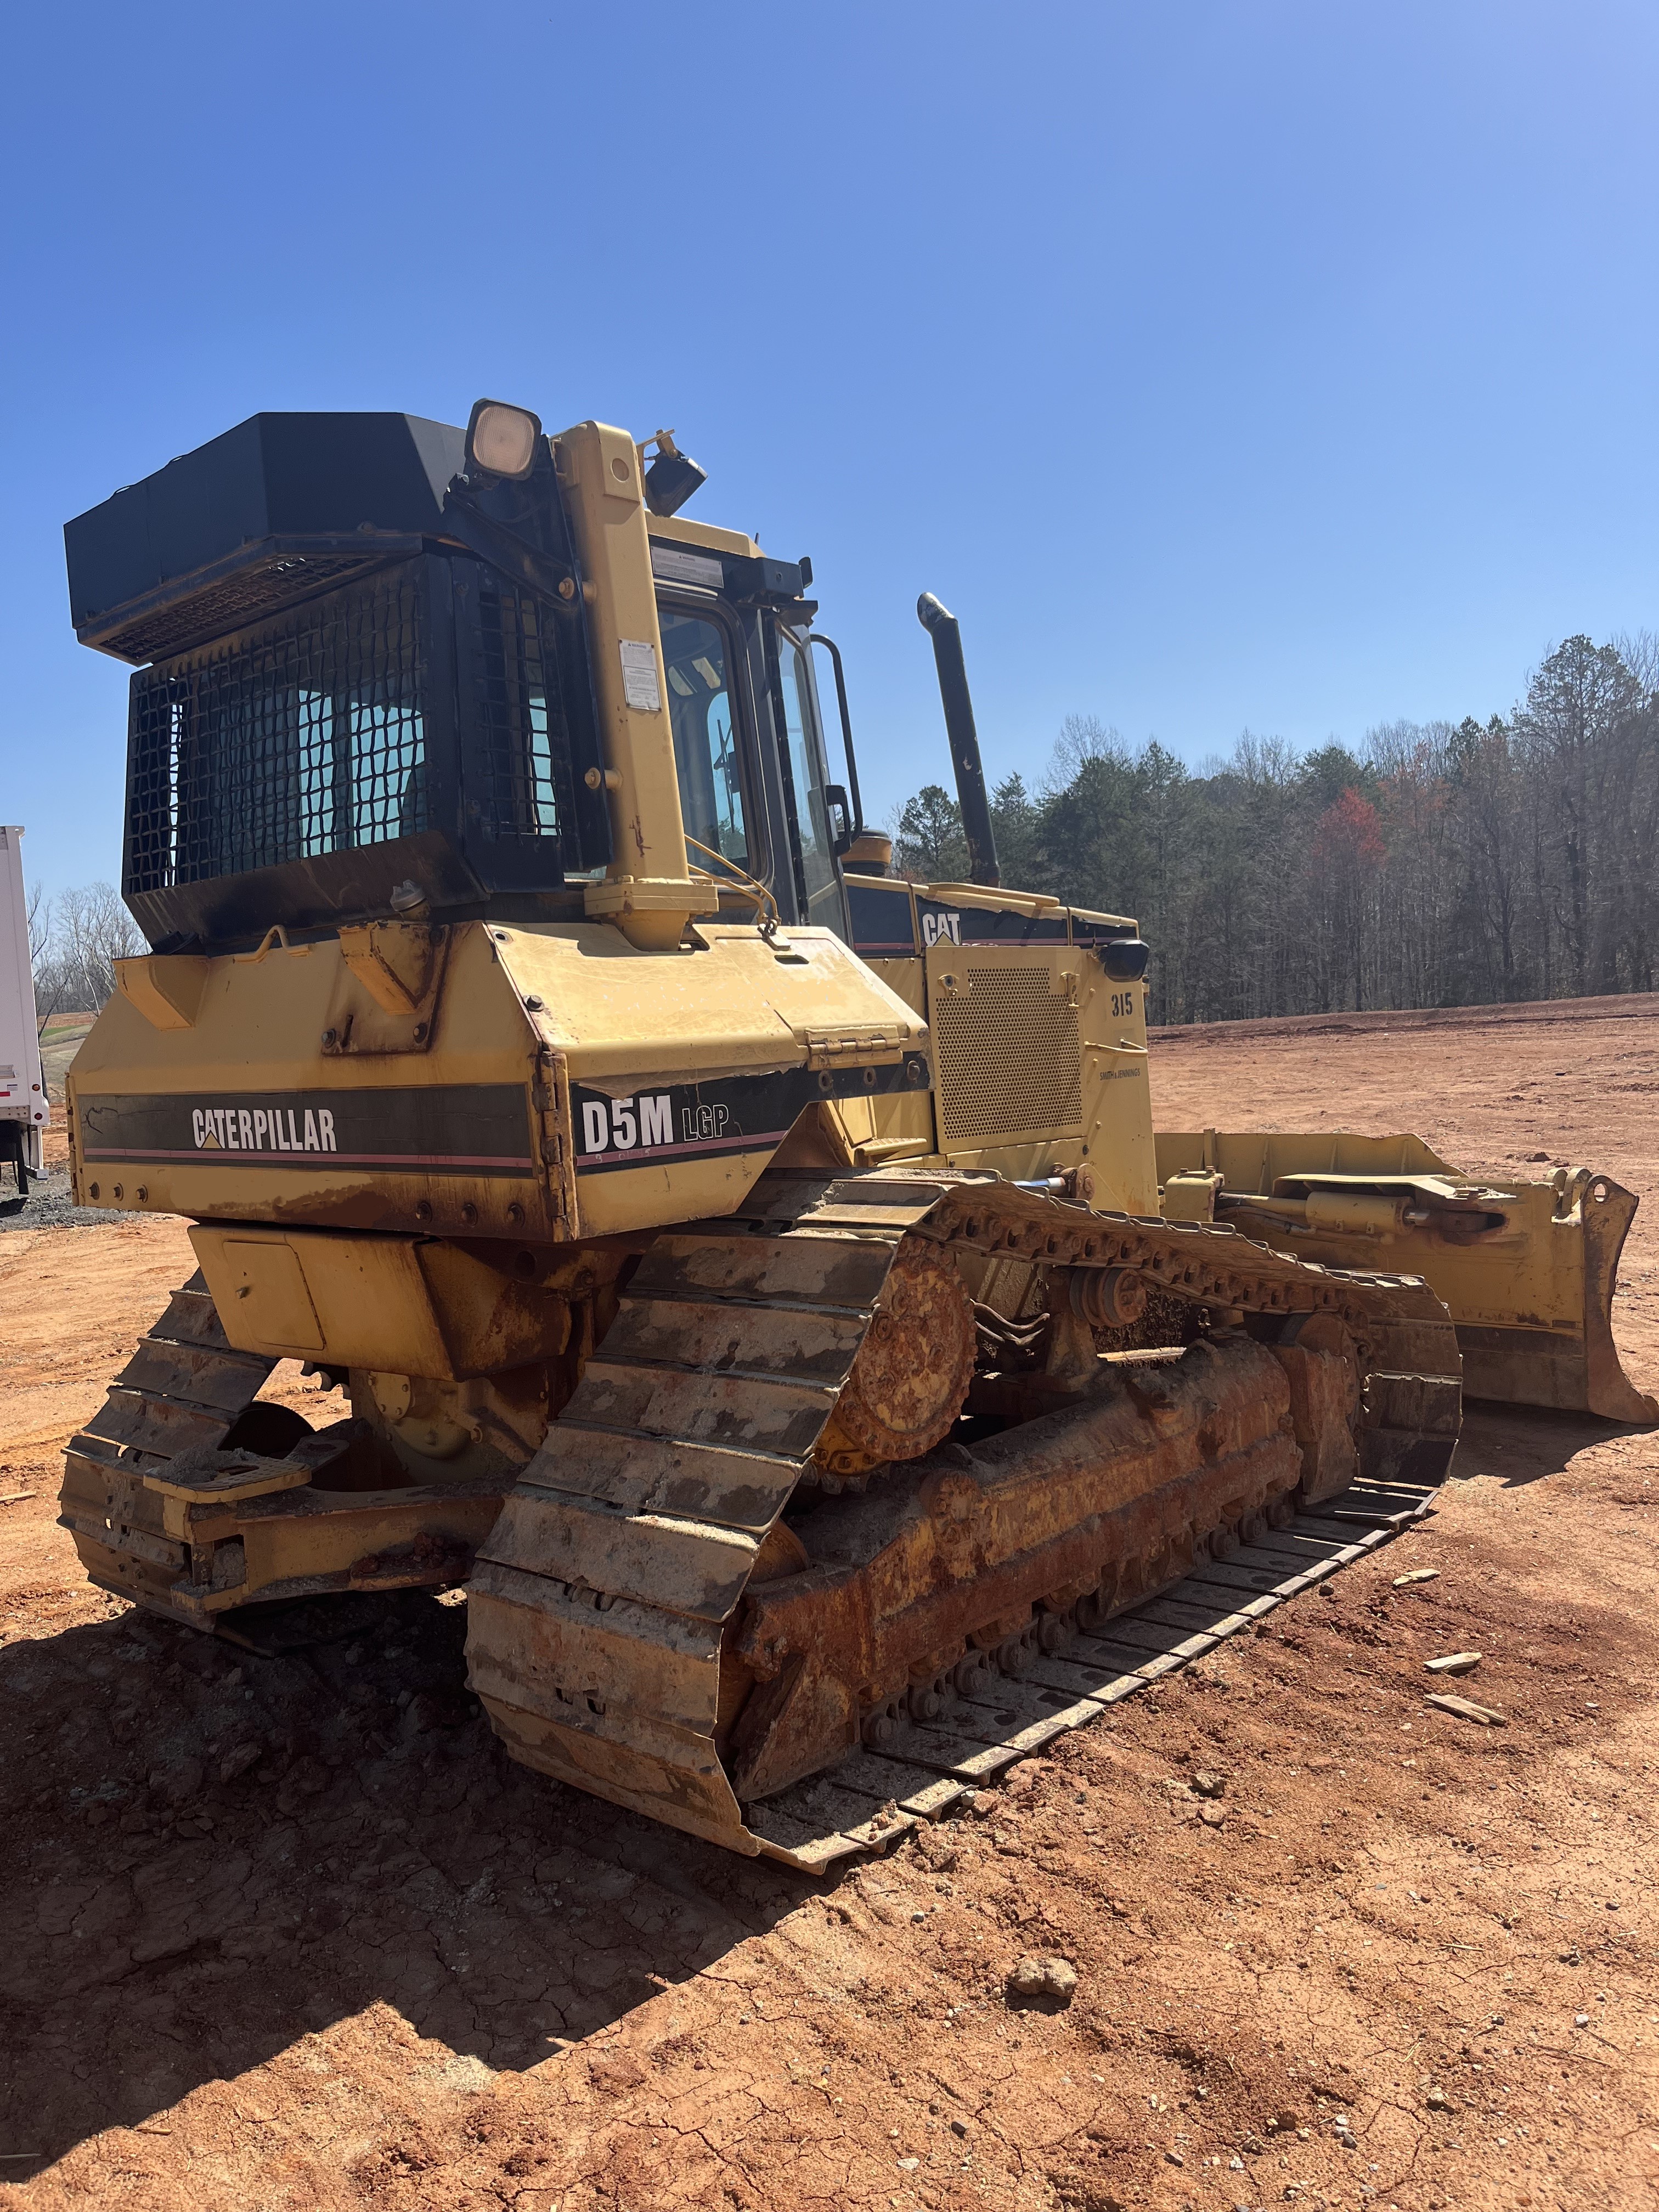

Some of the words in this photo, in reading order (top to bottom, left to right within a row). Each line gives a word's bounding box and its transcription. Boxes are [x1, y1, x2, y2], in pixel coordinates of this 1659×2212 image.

[922, 913, 960, 947] CAT
[1111, 992, 1133, 1017] 315
[1100, 1070, 1114, 1081] SMITH
[1118, 1068, 1141, 1079] JENNINGS
[192, 1109, 337, 1152] CATERPILLAR
[582, 1095, 674, 1153] D5M
[682, 1104, 729, 1142] LGP
